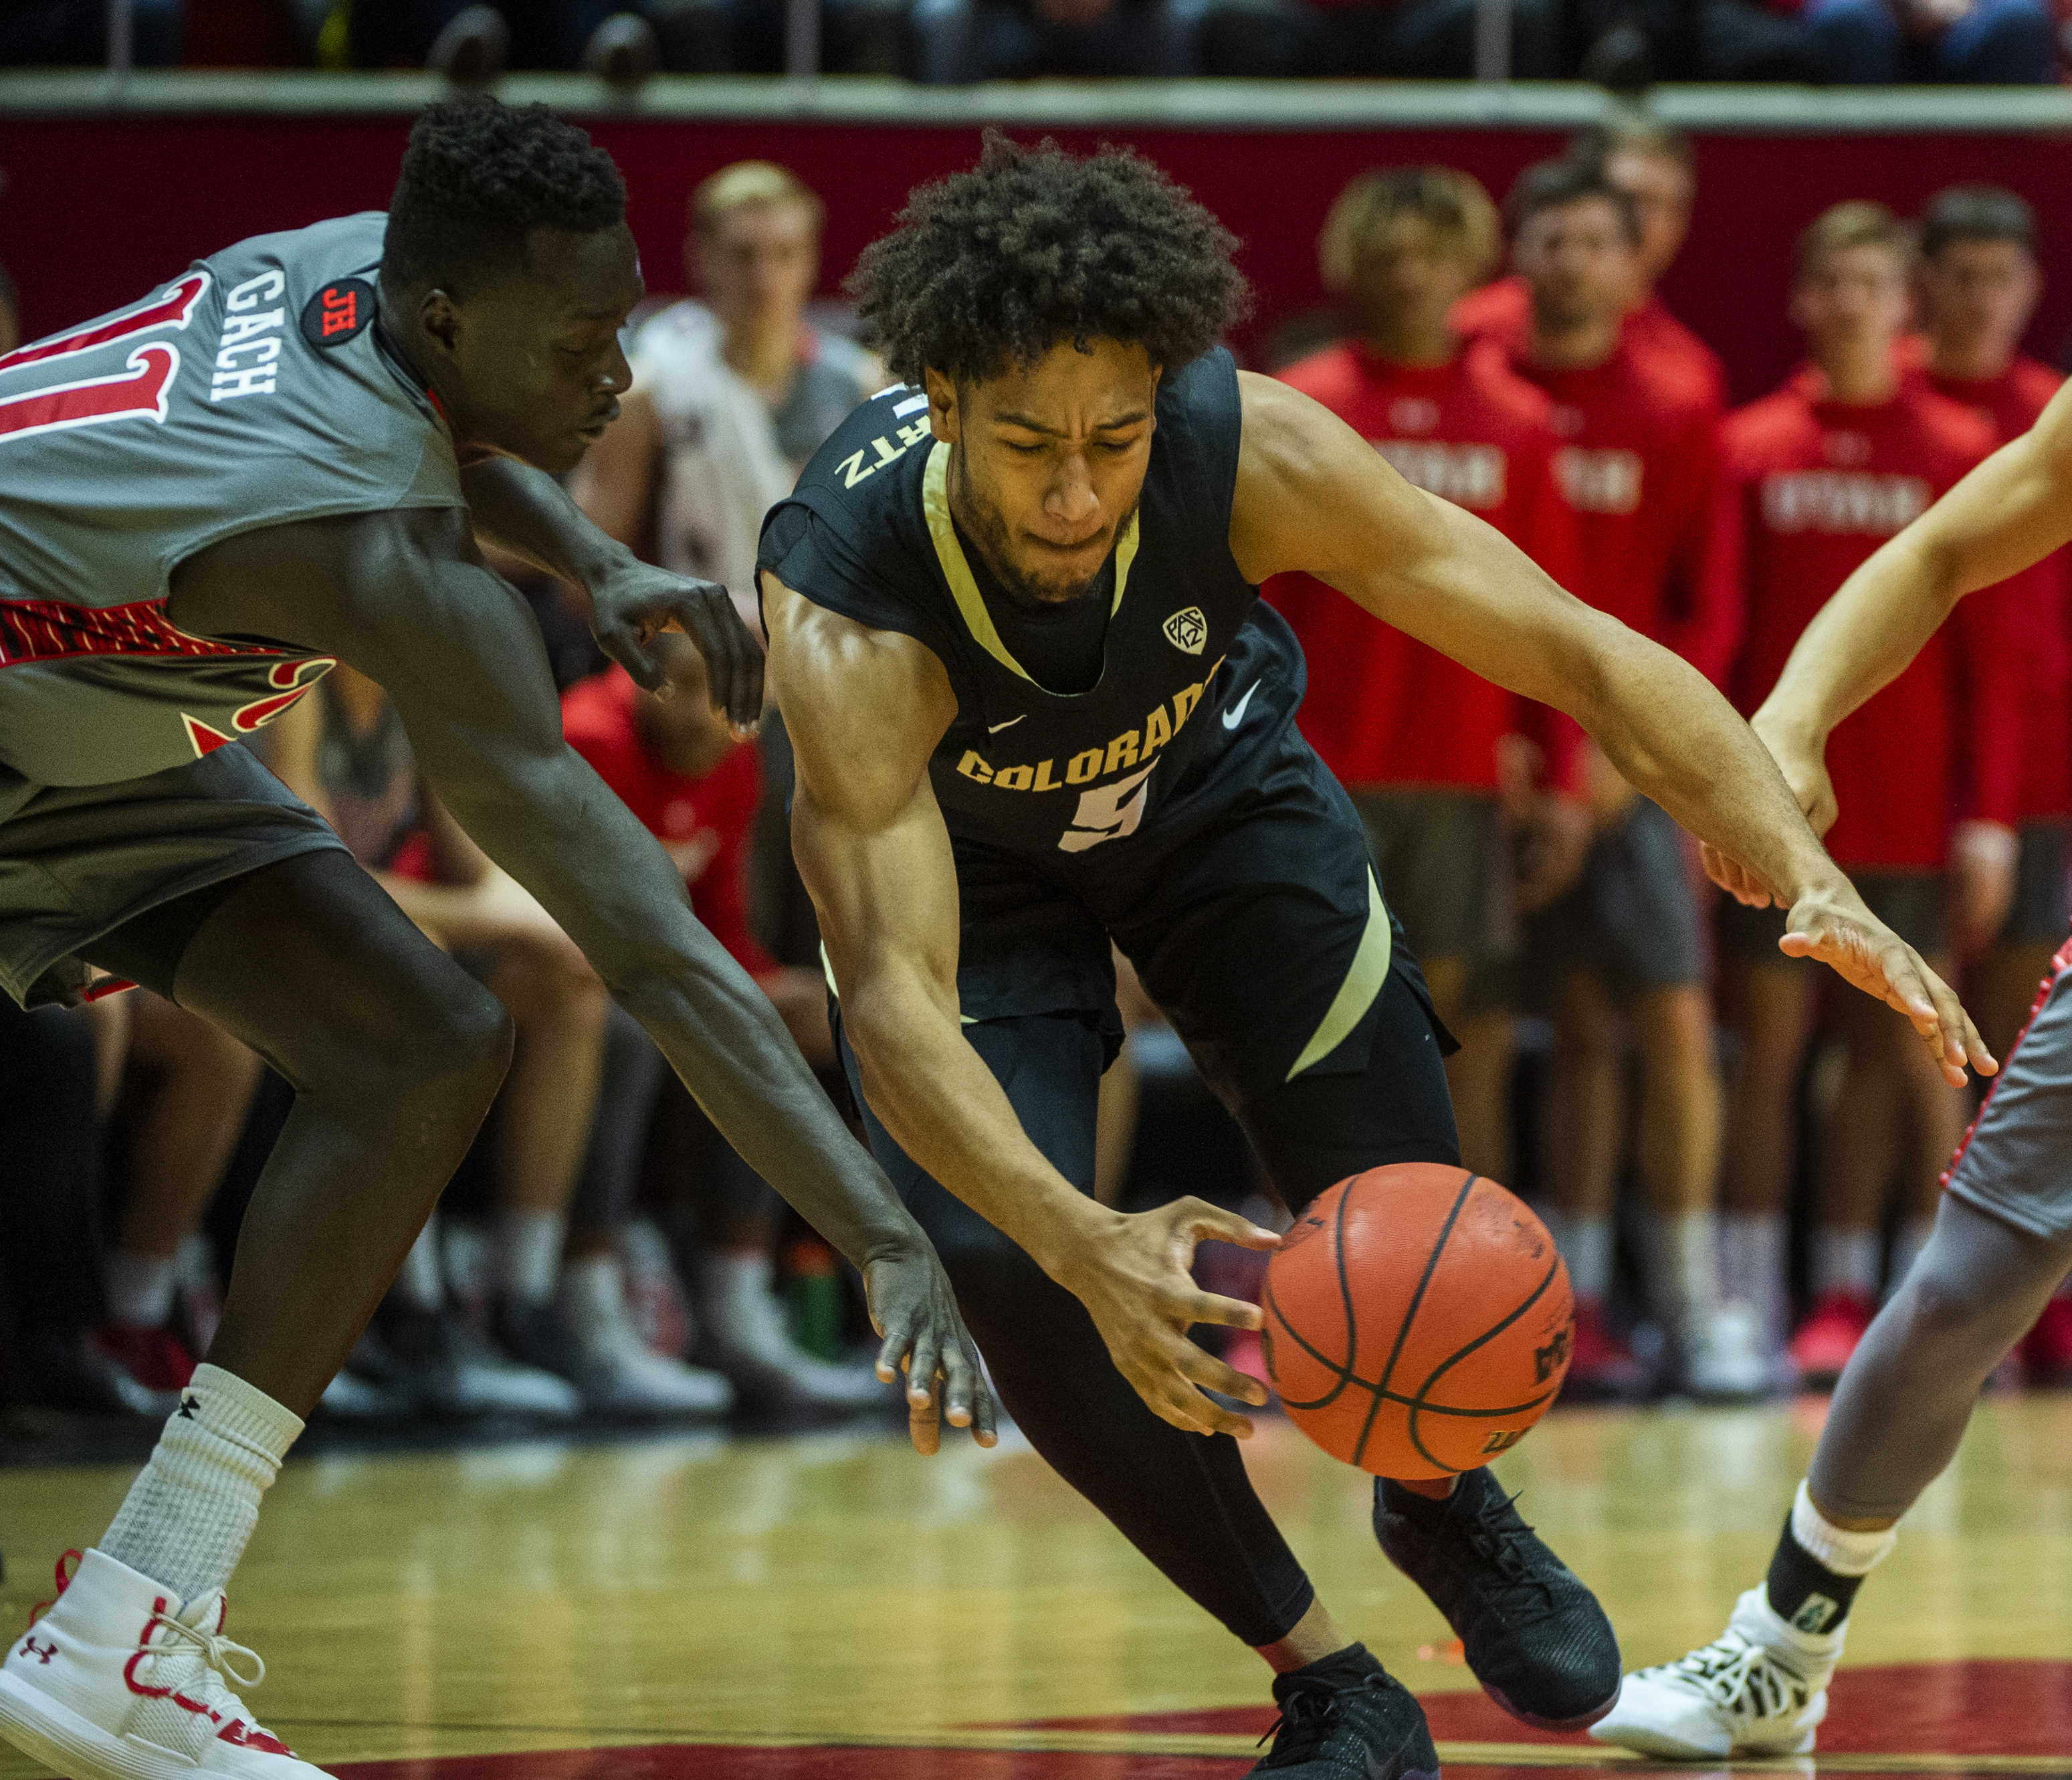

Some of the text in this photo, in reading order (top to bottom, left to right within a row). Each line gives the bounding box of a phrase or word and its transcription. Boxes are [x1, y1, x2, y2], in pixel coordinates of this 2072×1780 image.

[210, 269, 285, 401] GACH
[322, 288, 356, 337] JH
[1166, 609, 1205, 644] PAC
[1182, 628, 1203, 648] 12
[1057, 754, 1161, 853] 5
